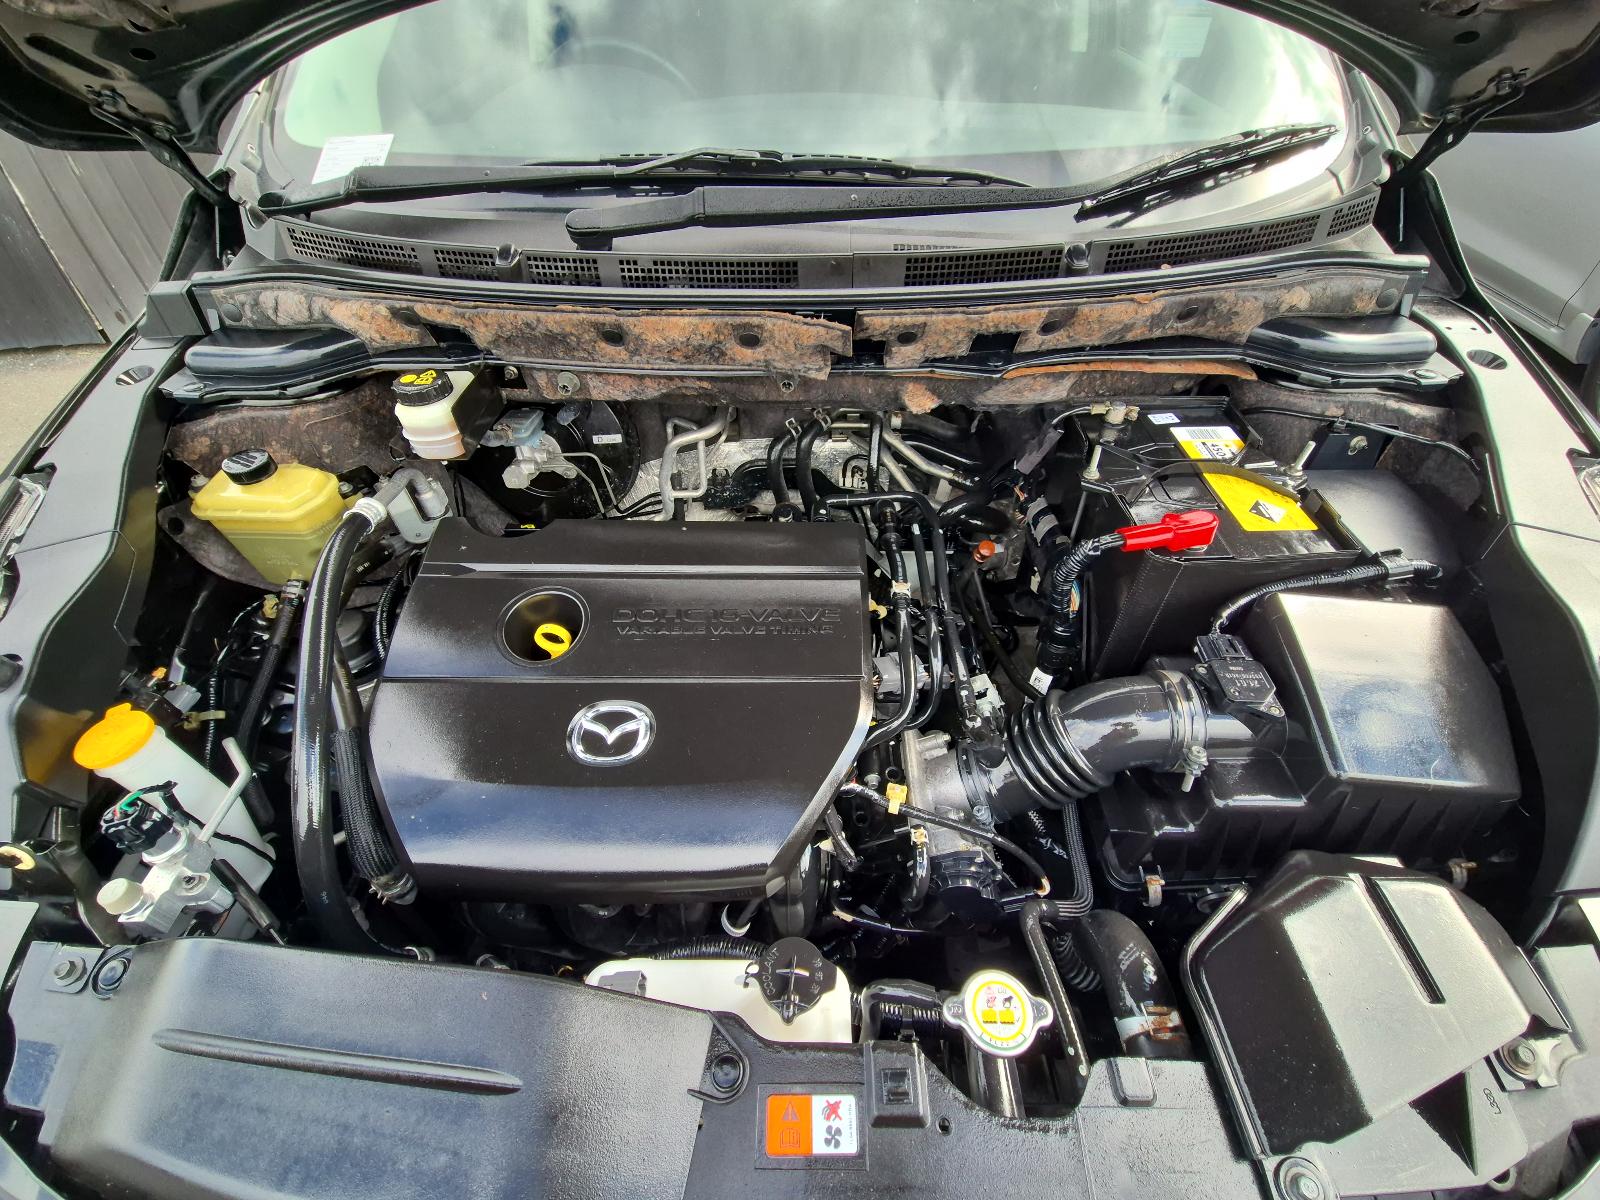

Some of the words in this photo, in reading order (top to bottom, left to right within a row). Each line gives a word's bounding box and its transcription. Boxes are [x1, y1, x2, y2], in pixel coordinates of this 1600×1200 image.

[612, 608, 706, 623] DOHC
[616, 625, 706, 635] VARIABLE
[710, 625, 767, 635] VALVE
[769, 625, 834, 635] TIMING
[762, 947, 780, 996] COOLANT
